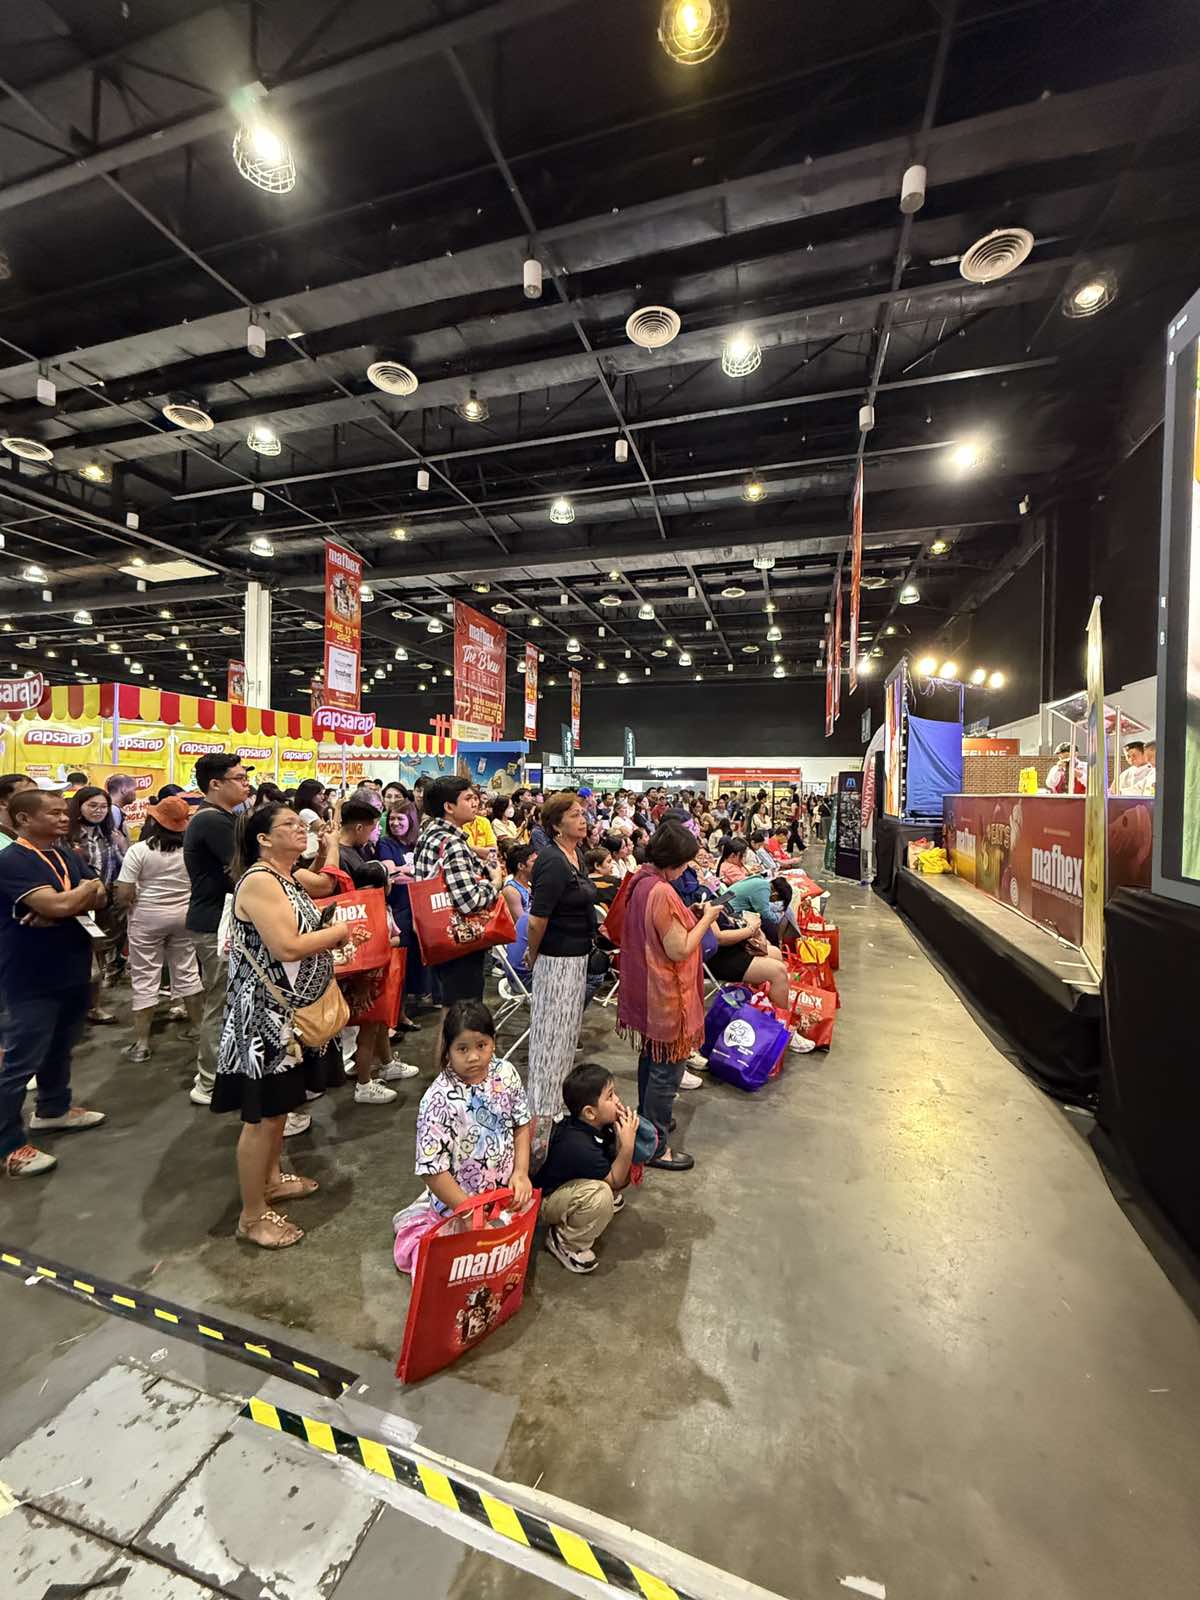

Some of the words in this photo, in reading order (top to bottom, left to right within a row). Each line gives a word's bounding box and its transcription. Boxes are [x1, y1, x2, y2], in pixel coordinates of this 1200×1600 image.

[317, 711, 373, 733] rapsarap
[27, 730, 91, 746] rapsarap
[181, 743, 225, 755] rapsarap
[236, 747, 272, 759] rapsarap
[283, 752, 313, 762] rapsarap
[1032, 844, 1082, 898] mafbex
[448, 1231, 528, 1282] mafbex
